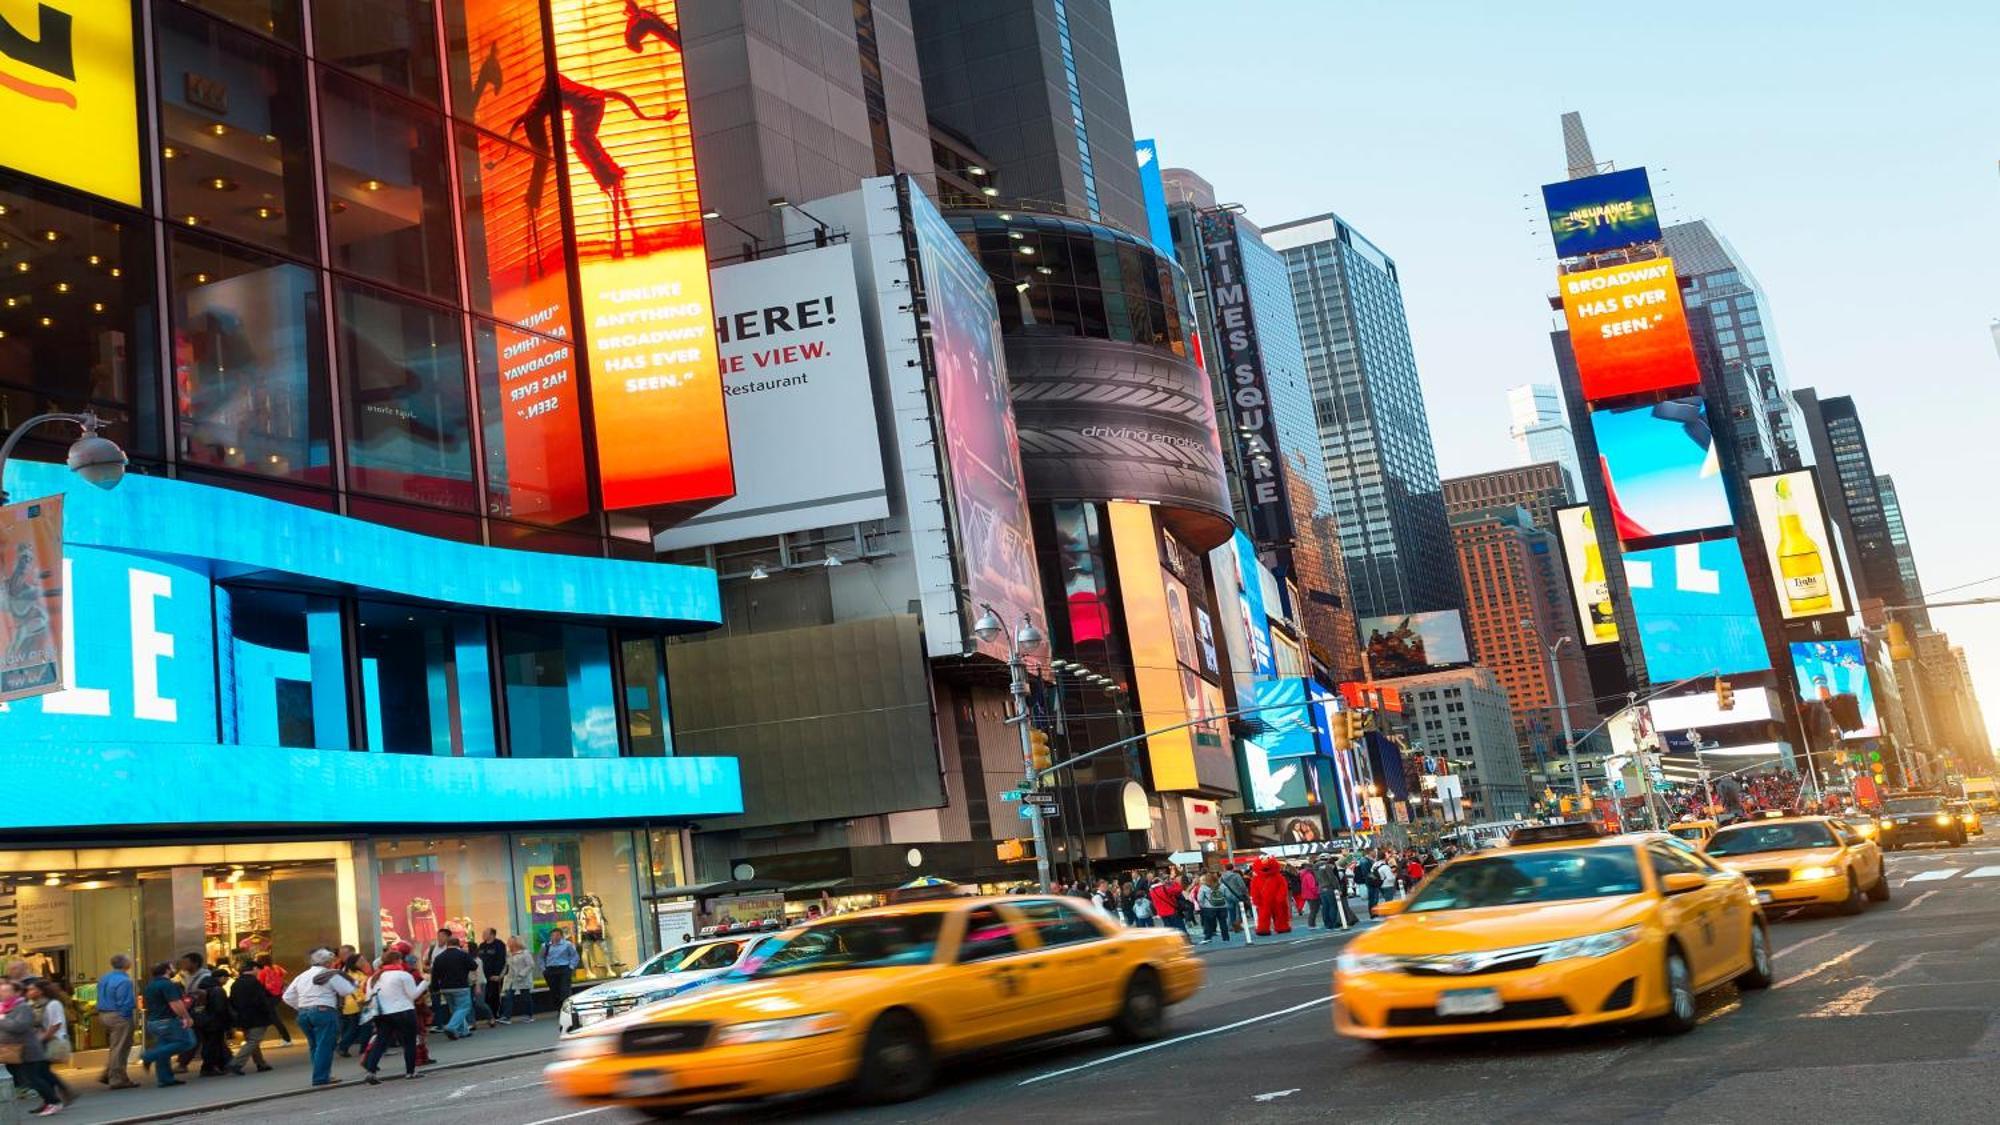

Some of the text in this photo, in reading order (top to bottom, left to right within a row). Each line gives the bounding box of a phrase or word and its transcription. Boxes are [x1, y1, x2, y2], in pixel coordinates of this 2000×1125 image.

[1568, 265, 1669, 294] BROADWAY
[595, 302, 702, 328] ANYTHING
[1578, 288, 1667, 318] HAS EVER
[597, 325, 706, 350] BROADWAY
[605, 347, 701, 373] HAS EVER
[753, 341, 831, 368] VIEW.
[1208, 240, 1279, 504] TIMES SQUARE
[1081, 426, 1206, 451] driving emotion
